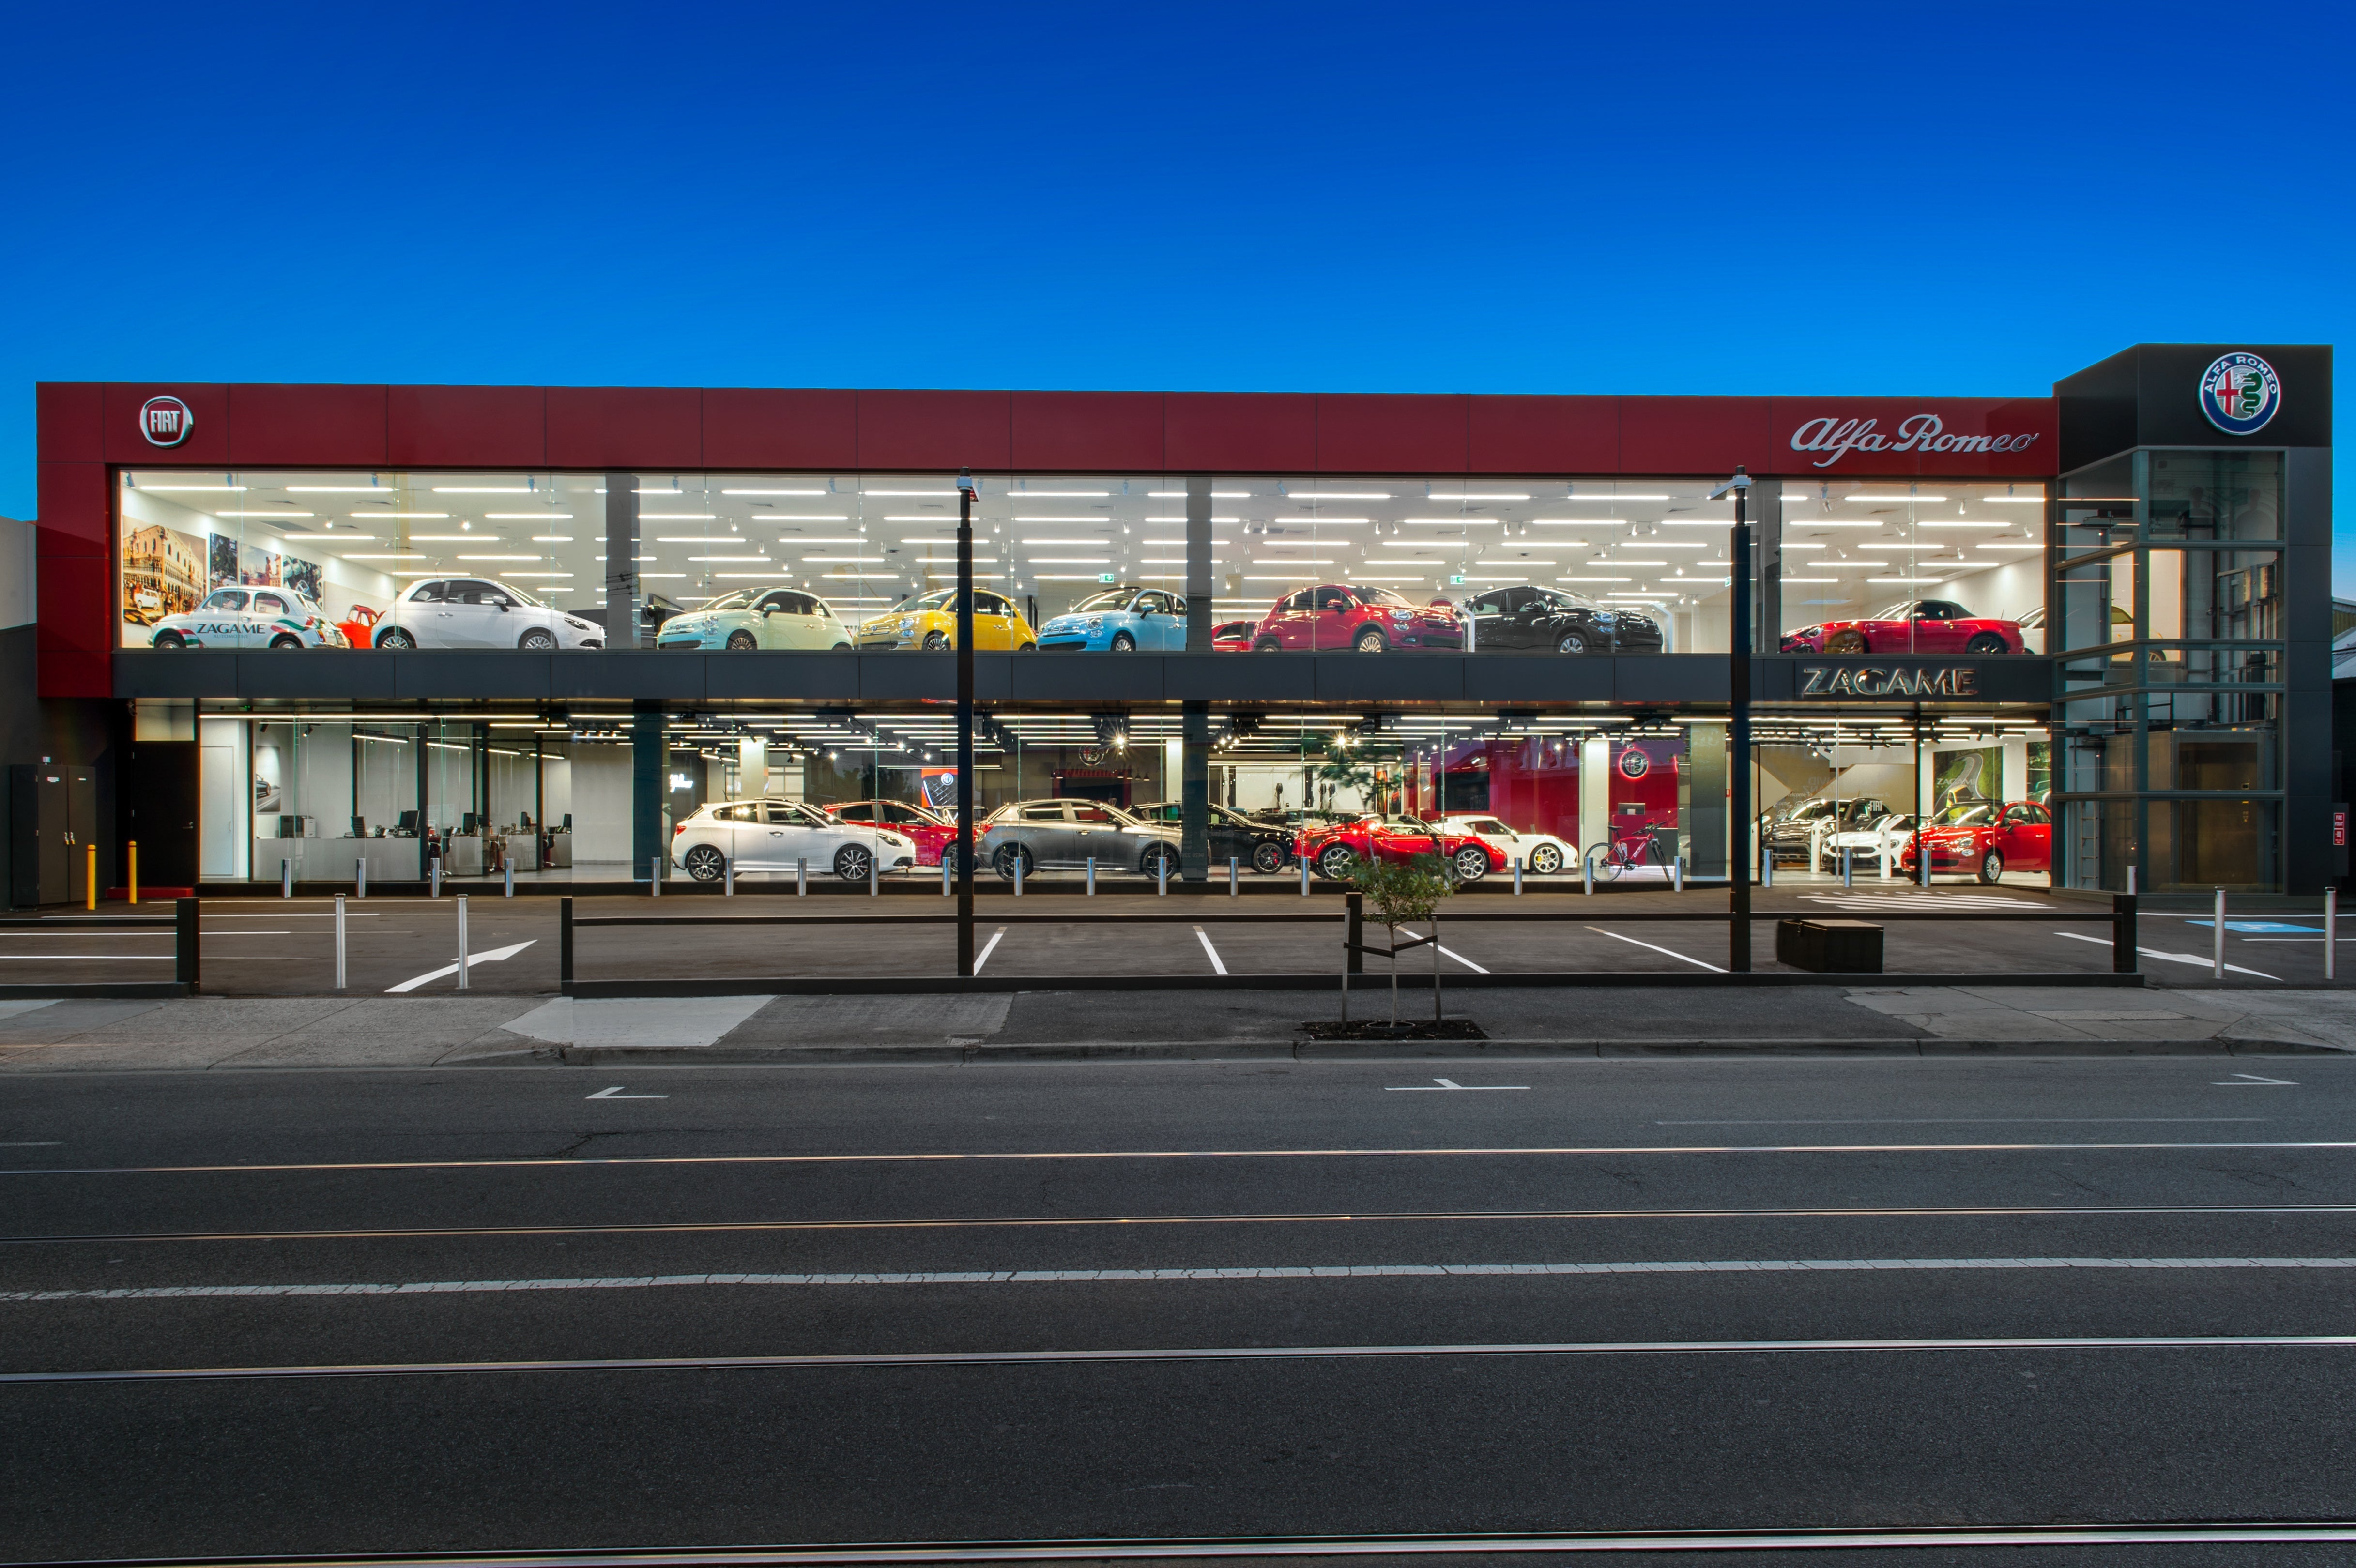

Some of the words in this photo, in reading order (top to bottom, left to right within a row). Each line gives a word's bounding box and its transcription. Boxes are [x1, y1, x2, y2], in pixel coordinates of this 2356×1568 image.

[2204, 360, 2232, 393] ALFA
[2236, 356, 2277, 394] ROMEO
[150, 410, 181, 432] FIAT
[1790, 418, 1893, 468] Alfa
[1891, 414, 2040, 452] Romeo
[197, 623, 266, 634] ZAGAME
[1803, 668, 1979, 695] ZAGAME
[1869, 800, 1883, 812] FIAT
